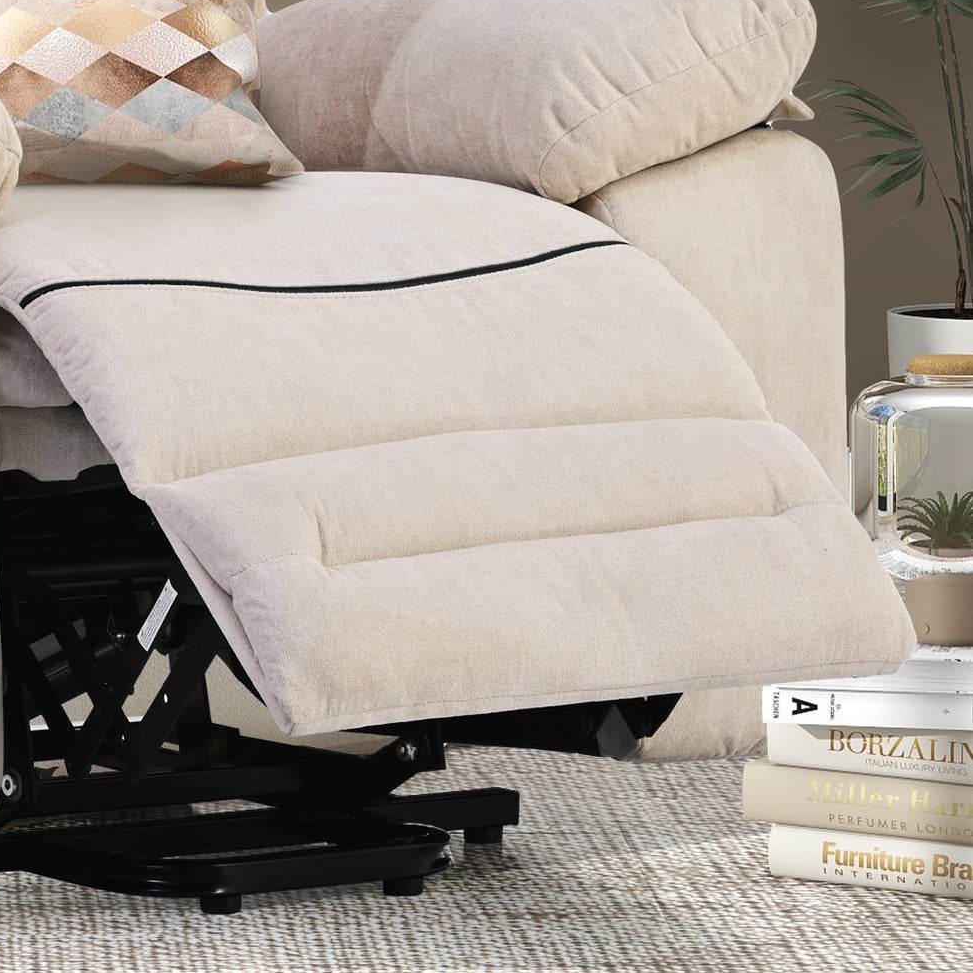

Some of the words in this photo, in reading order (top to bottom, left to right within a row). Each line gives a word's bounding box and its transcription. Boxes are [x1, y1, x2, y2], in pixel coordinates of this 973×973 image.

[792, 697, 818, 716] A
[828, 729, 973, 764] BORZALIN
[866, 758, 898, 769] ITALIAN
[899, 762, 936, 773] LUXURY
[938, 766, 968, 776] LIVING
[807, 779, 900, 810] Miller
[829, 813, 907, 831] PERFUMER
[822, 841, 925, 875] Furniture
[932, 853, 973, 881] Bra
[823, 868, 966, 890] INTERNATIO
